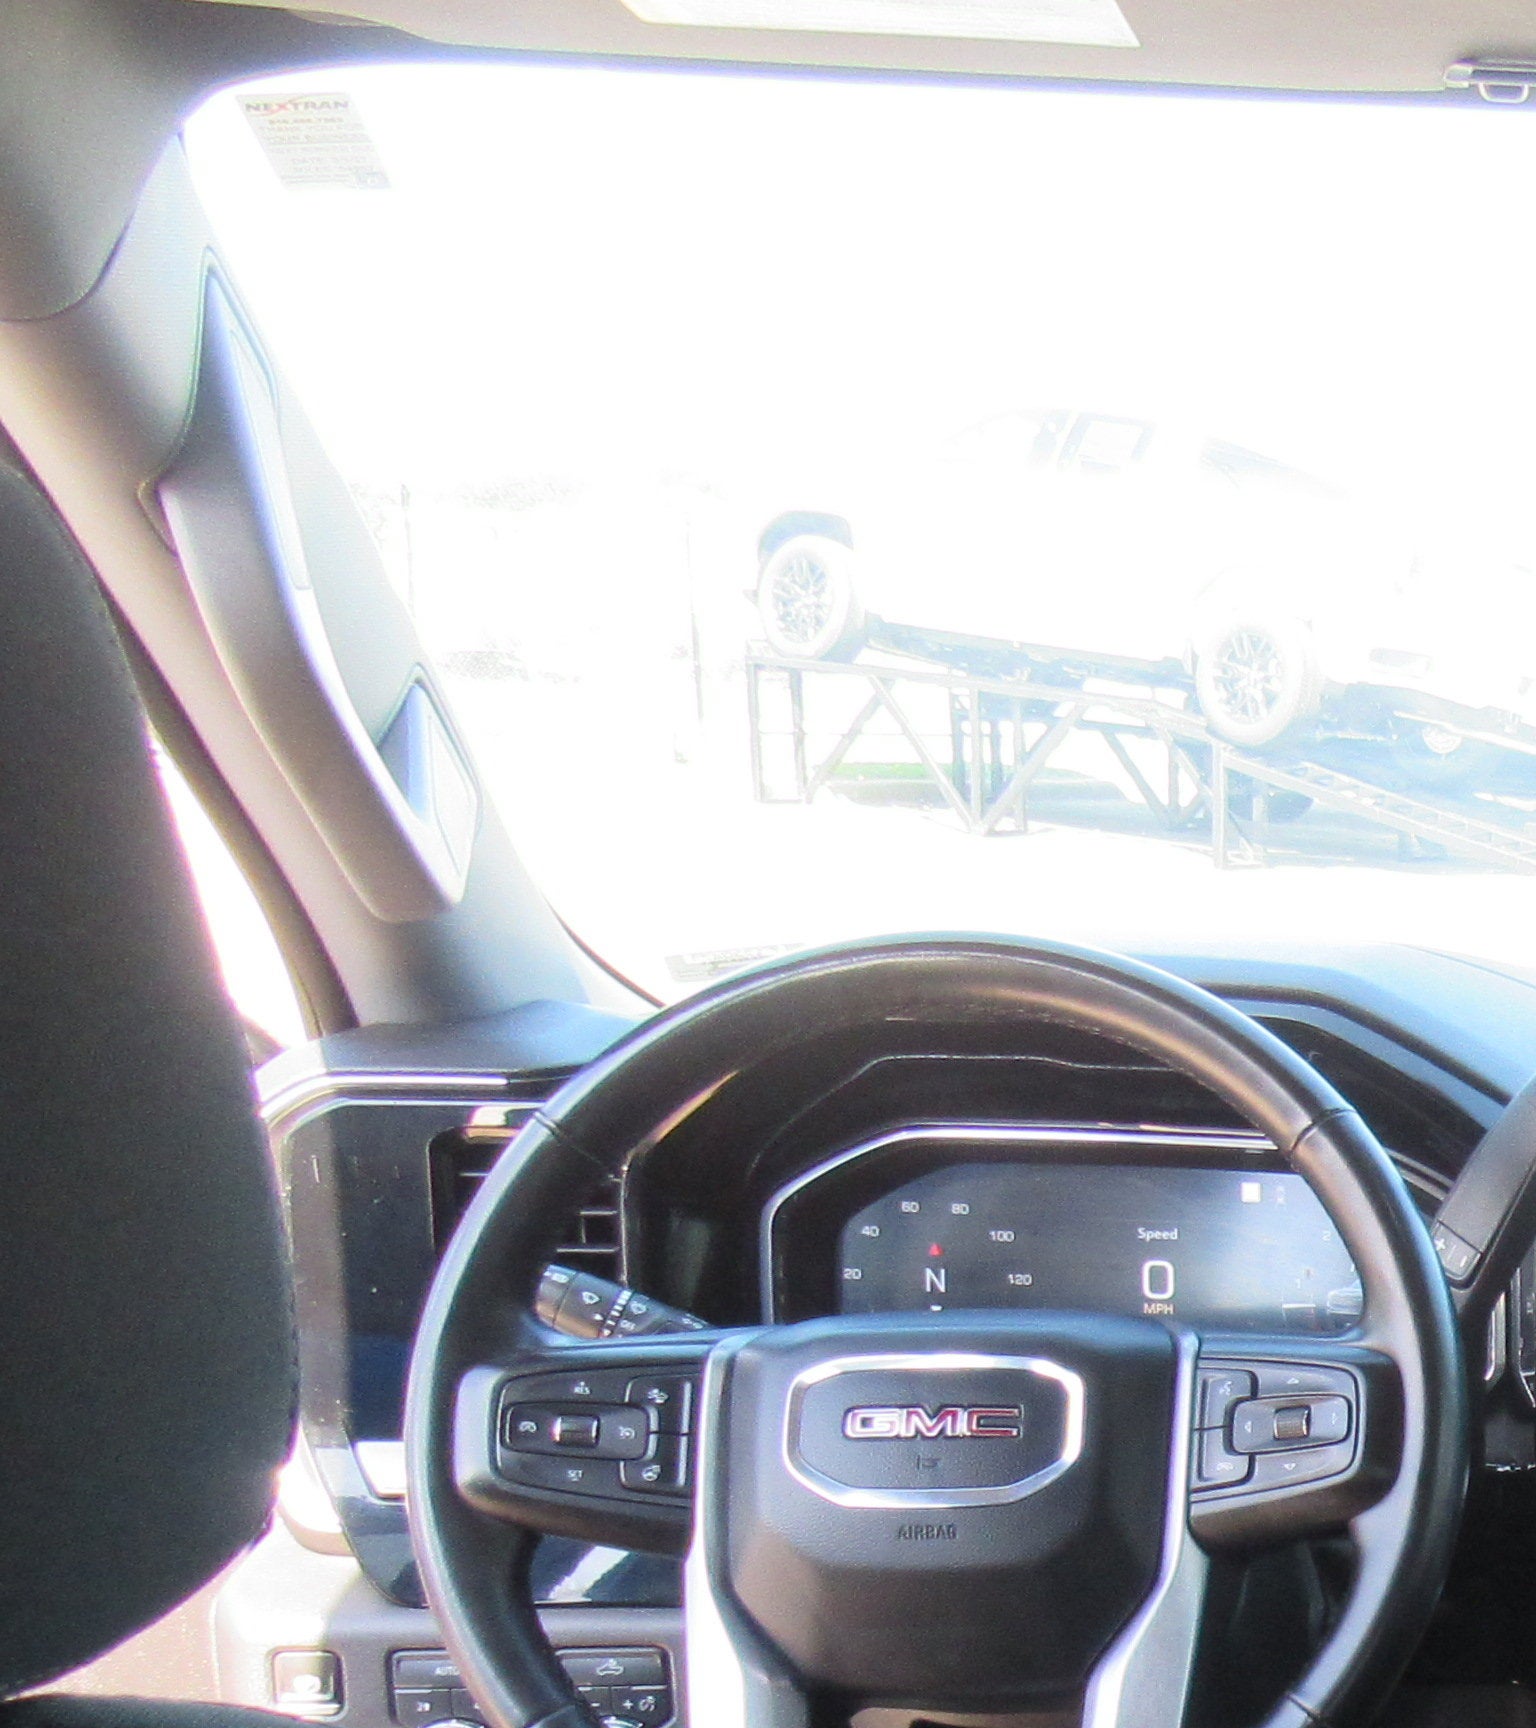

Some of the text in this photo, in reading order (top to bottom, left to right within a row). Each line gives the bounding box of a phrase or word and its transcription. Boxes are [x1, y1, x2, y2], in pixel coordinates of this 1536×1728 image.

[245, 101, 349, 112] NEXTRAN
[901, 1202, 920, 1214] 60
[951, 1204, 970, 1215] 80
[861, 1225, 880, 1238] 40
[989, 1230, 1015, 1243] 100
[1137, 1226, 1178, 1243] Speed
[844, 1268, 862, 1280] 20
[924, 1268, 946, 1293] N
[1008, 1274, 1033, 1287] 120
[1141, 1259, 1174, 1300] 0
[1143, 1302, 1174, 1316] MPH
[843, 1405, 1020, 1439] GMC
[897, 1524, 958, 1540] AIRBAG
